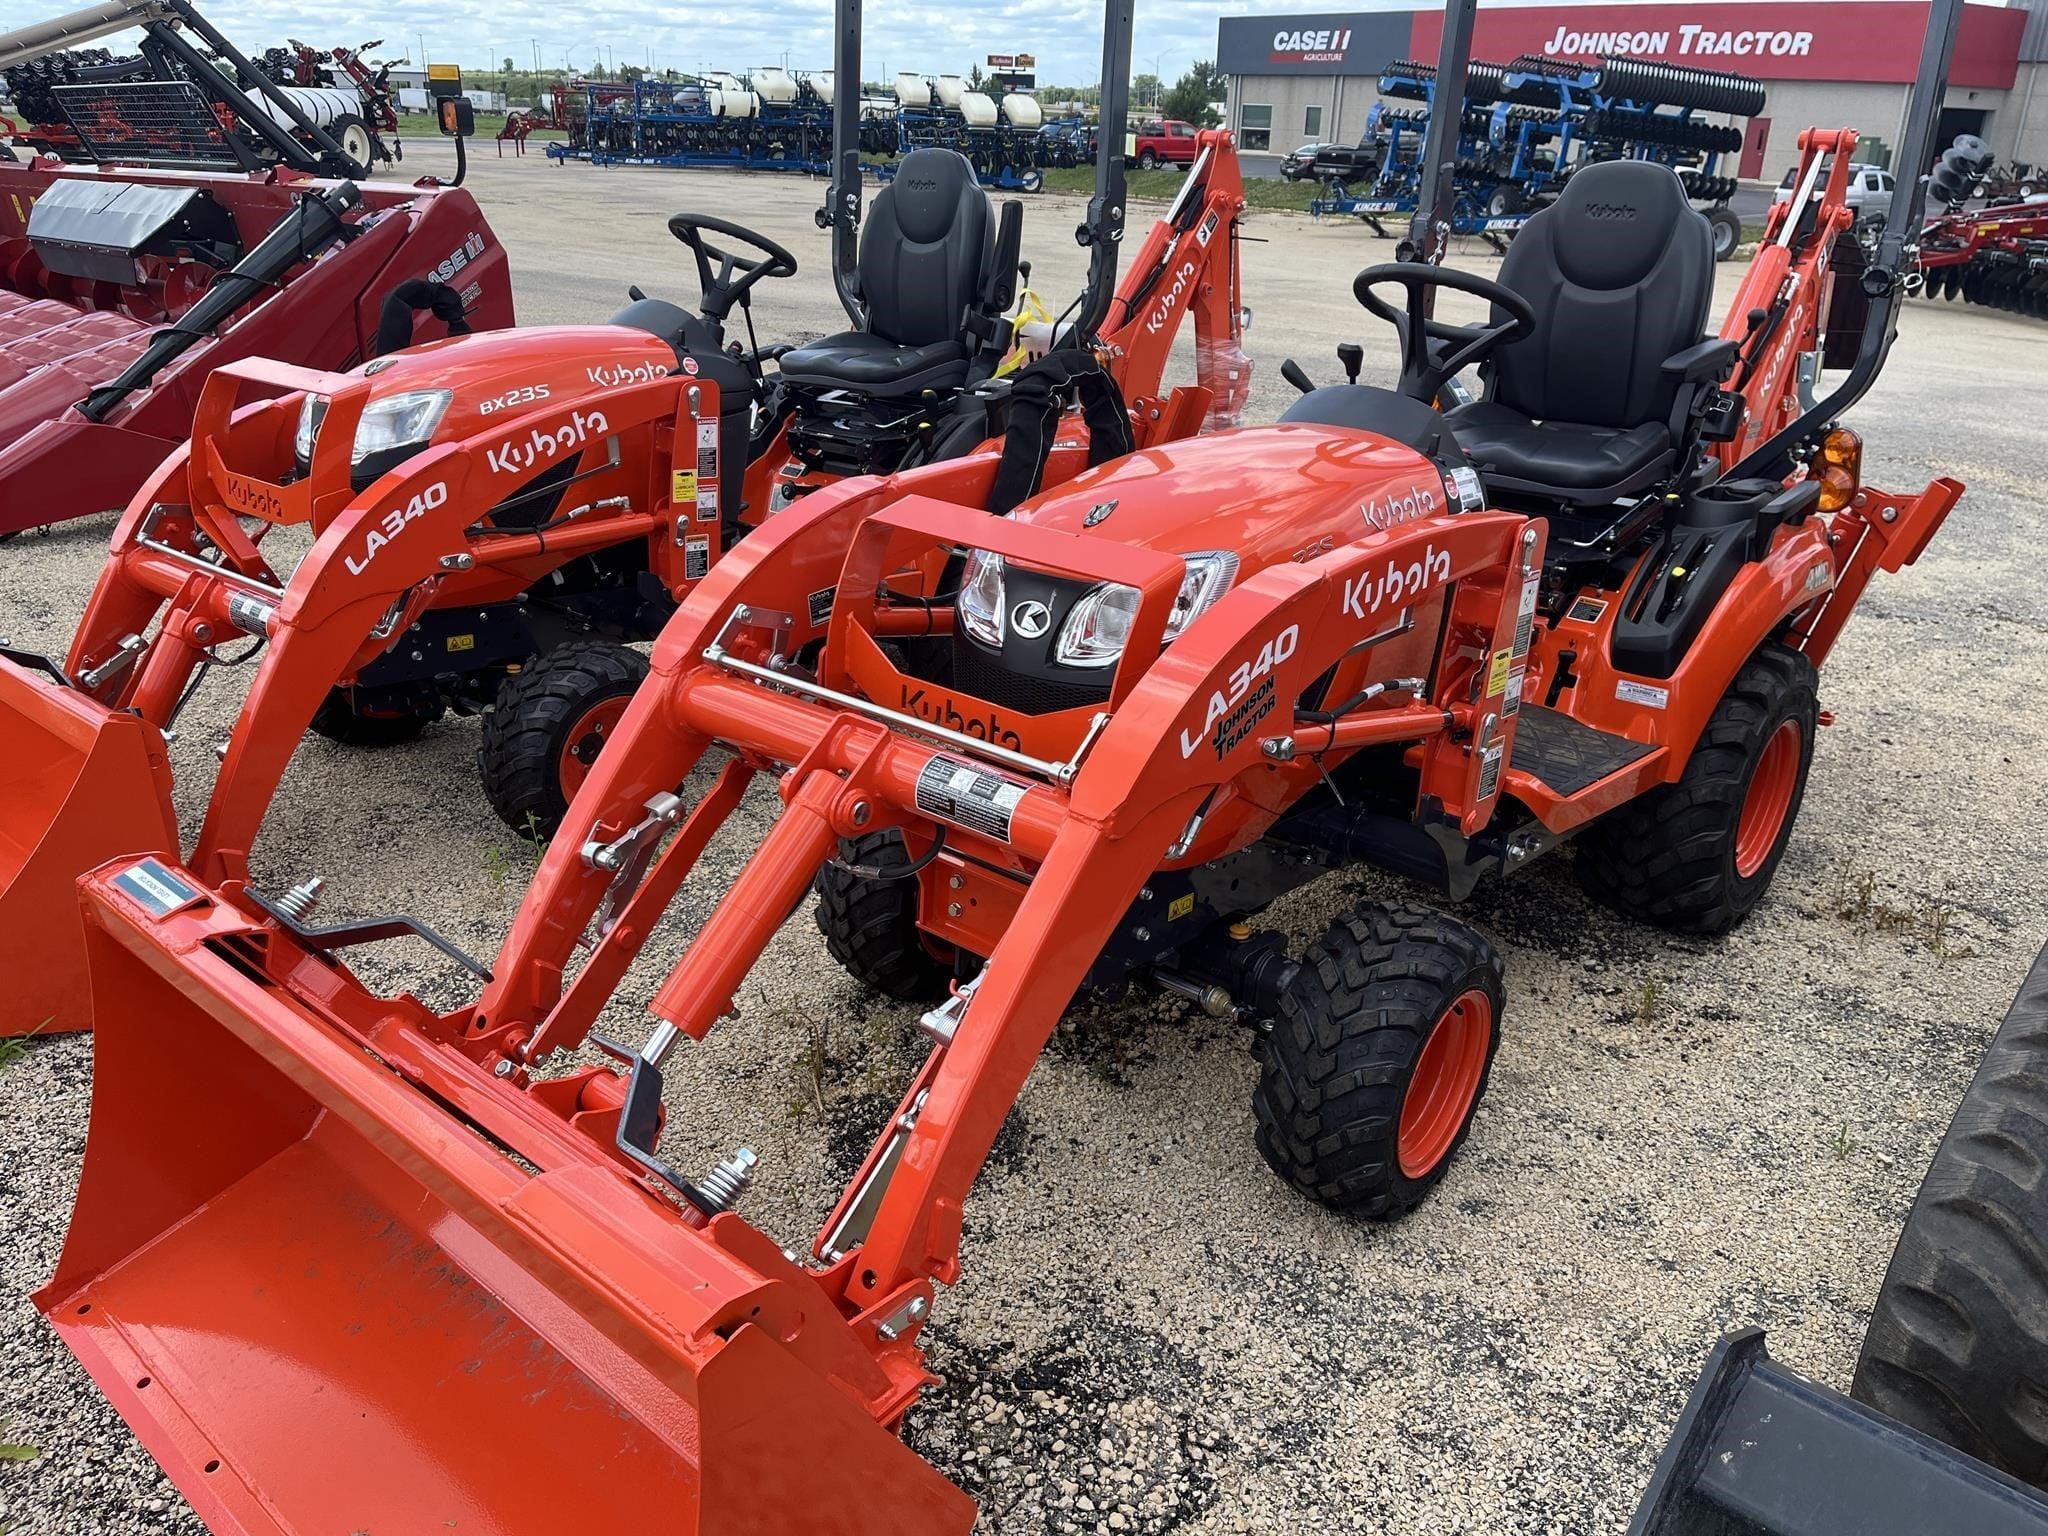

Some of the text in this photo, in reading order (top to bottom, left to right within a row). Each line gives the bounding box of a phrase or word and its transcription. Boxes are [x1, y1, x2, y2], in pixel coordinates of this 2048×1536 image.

[1273, 30, 1330, 51] CASE
[1303, 53, 1344, 62] AGRICULTURE
[1544, 24, 1813, 56] JOHNSON TRACTOR
[1352, 202, 1382, 212] KINZE
[1485, 219, 1513, 229] KINZE
[1584, 203, 1637, 219] Kubota
[427, 247, 467, 283] ASE
[1147, 262, 1195, 335] Kubota
[1760, 304, 1804, 397] Kubota
[586, 360, 668, 387] Kubota
[479, 383, 550, 416] BX23S
[486, 411, 609, 474] Kubota
[227, 478, 282, 517] Kubota
[1360, 486, 1435, 531] Kubota
[344, 481, 448, 576] LA340
[1342, 543, 1451, 620] Kubota
[1180, 623, 1299, 760] LA340
[1212, 674, 1276, 746] JOHNSON
[901, 684, 1021, 753] Kubota
[1213, 693, 1276, 763] TRACTOR
